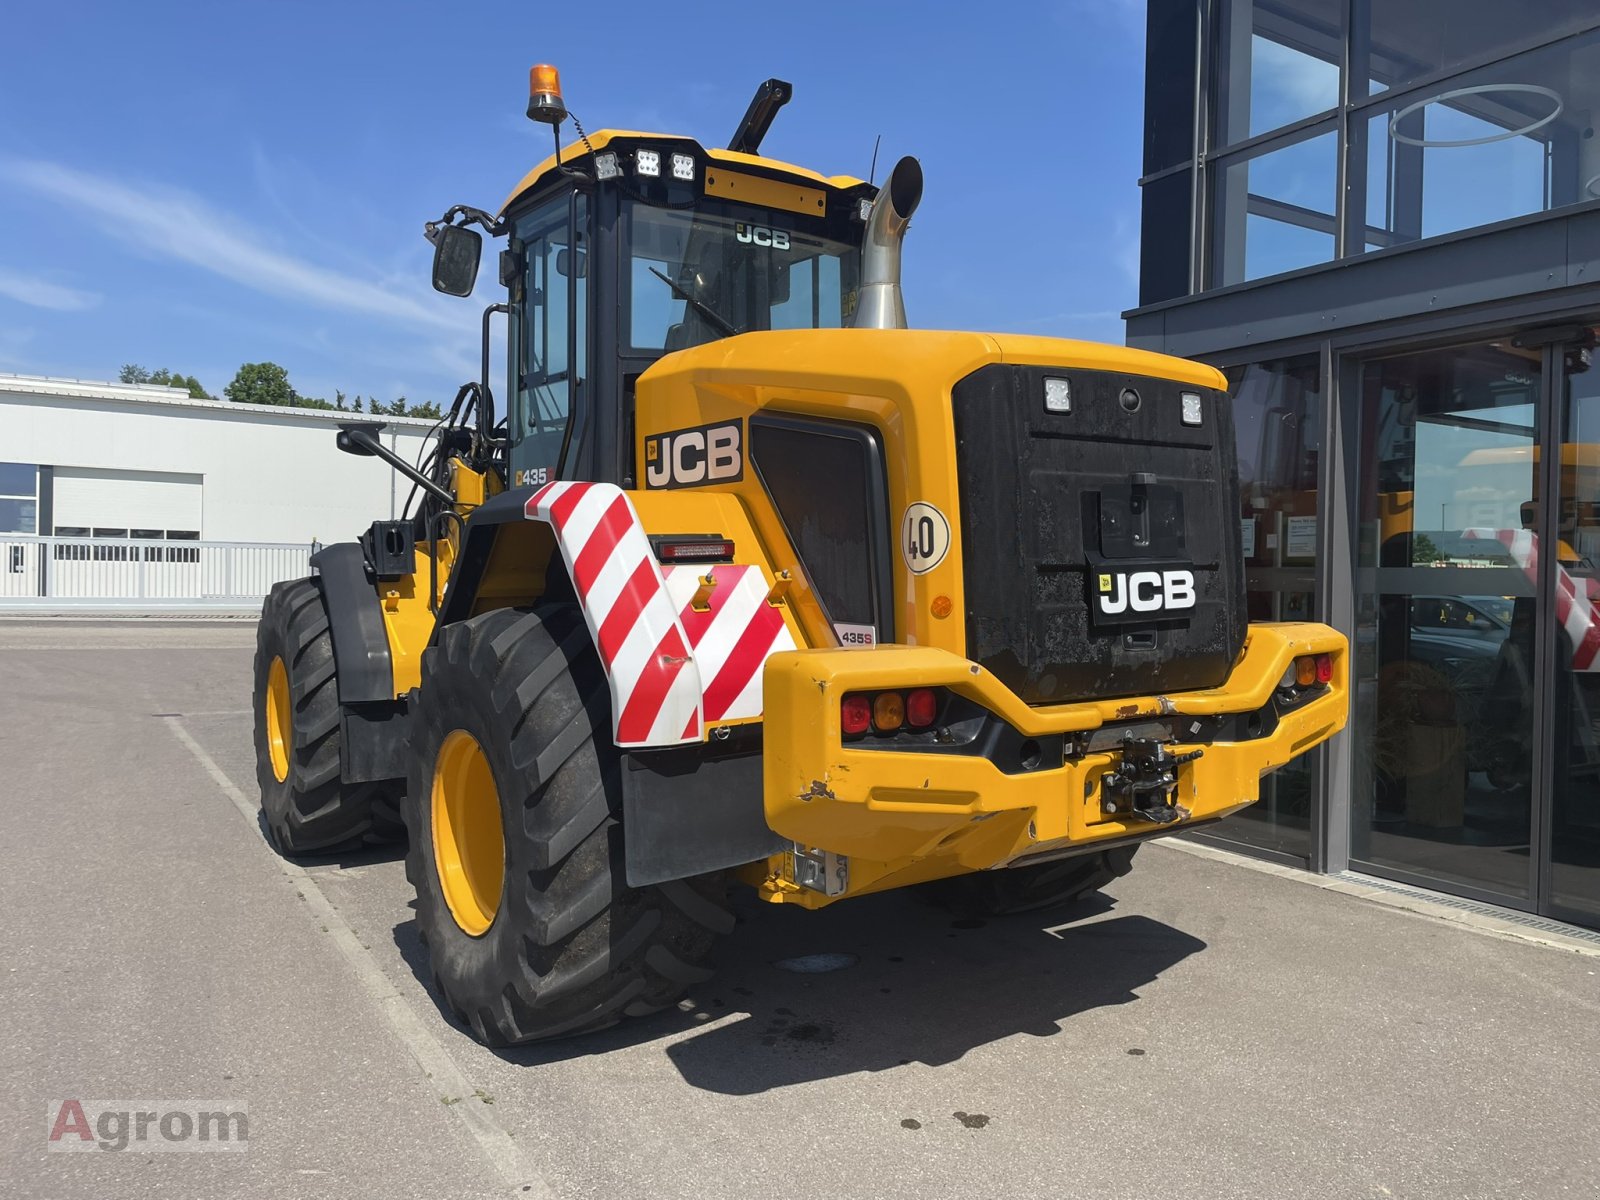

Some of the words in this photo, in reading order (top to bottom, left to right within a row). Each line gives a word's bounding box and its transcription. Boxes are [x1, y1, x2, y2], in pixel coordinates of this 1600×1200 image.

[736, 225, 790, 250] JCB
[647, 425, 741, 487] JCB
[908, 516, 935, 560] 40
[1100, 570, 1196, 614] JCB
[842, 632, 872, 644] 435S
